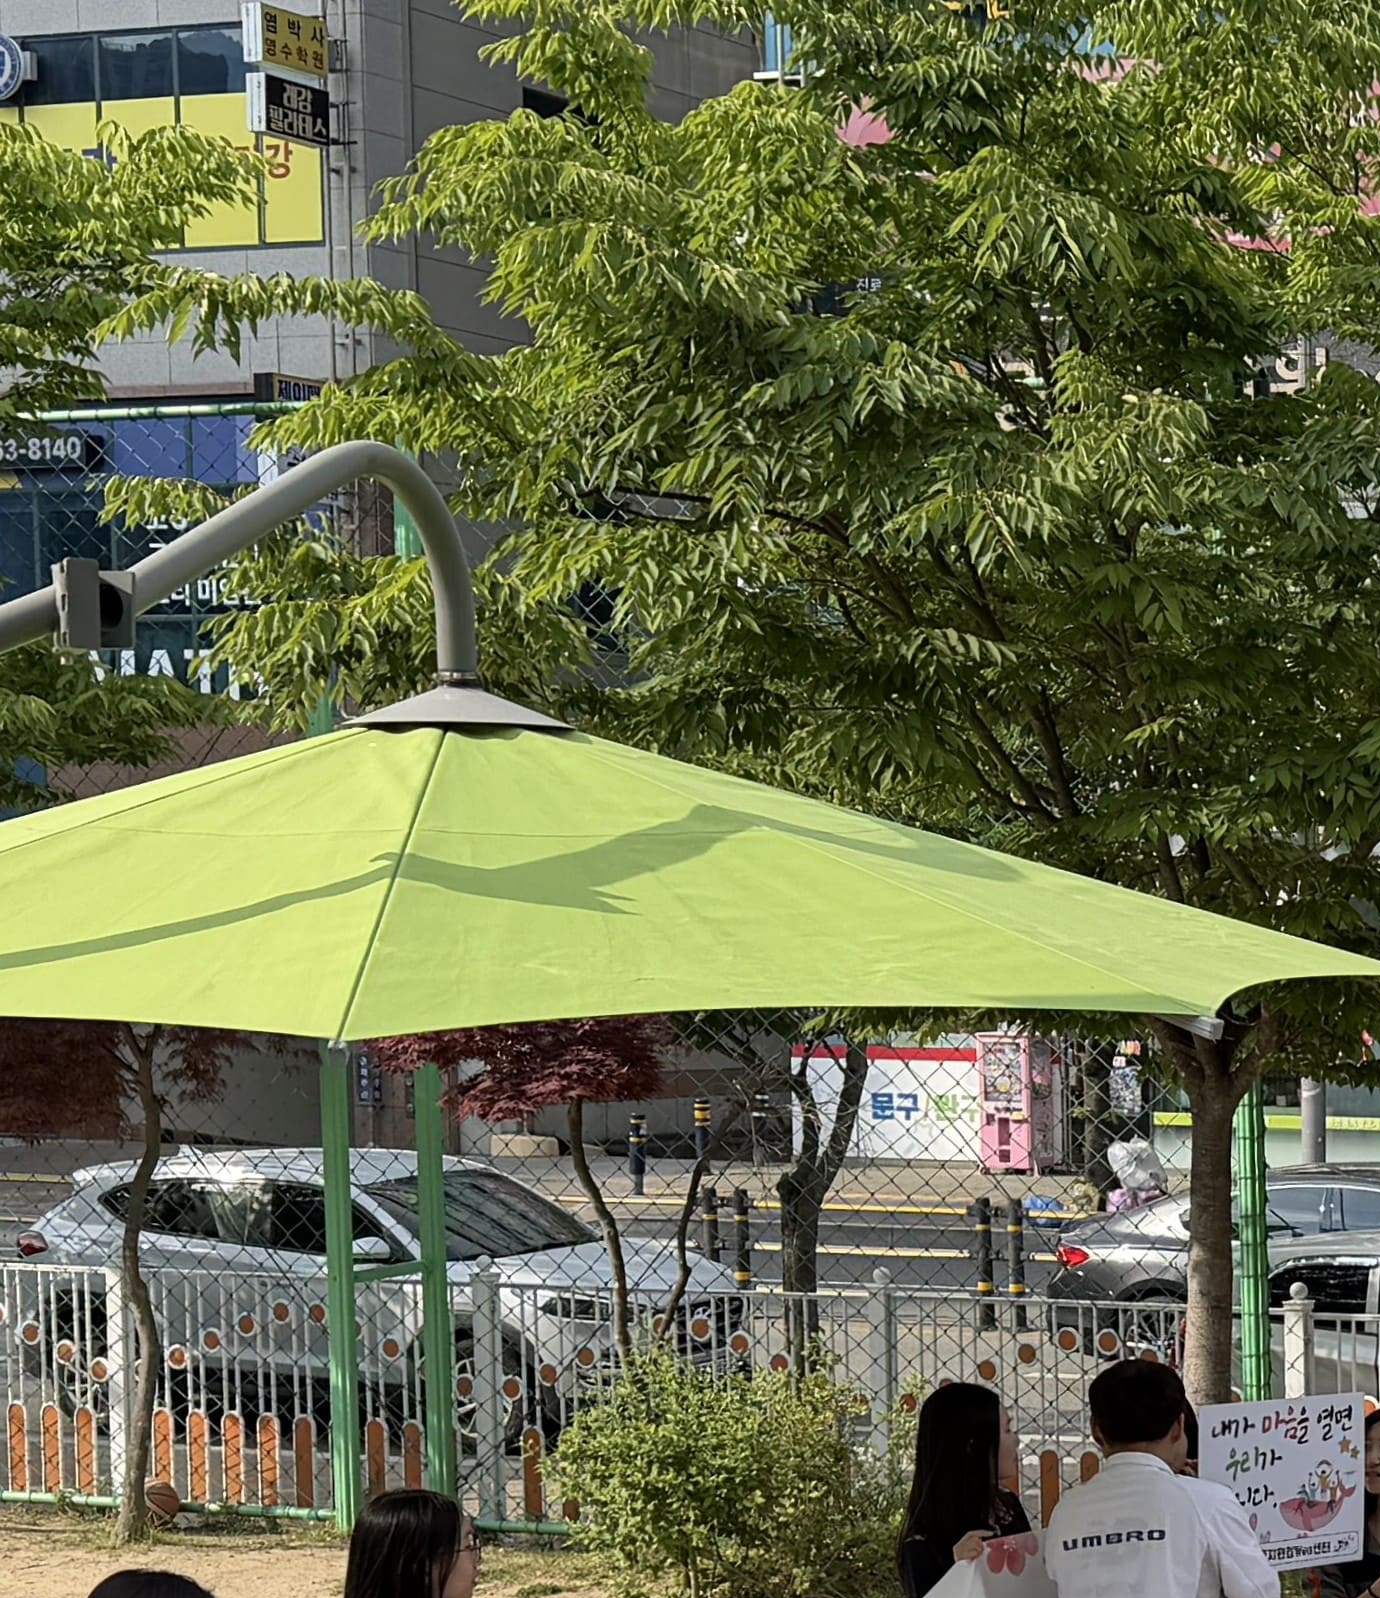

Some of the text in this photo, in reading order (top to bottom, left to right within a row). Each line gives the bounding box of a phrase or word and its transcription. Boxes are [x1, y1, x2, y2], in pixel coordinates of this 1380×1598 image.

[871, 1092, 920, 1122] 문구
[1211, 1404, 1353, 1444] 내가 마음을 열면
[1225, 1446, 1283, 1481] 우리가
[1063, 1529, 1166, 1551] UMBRO
